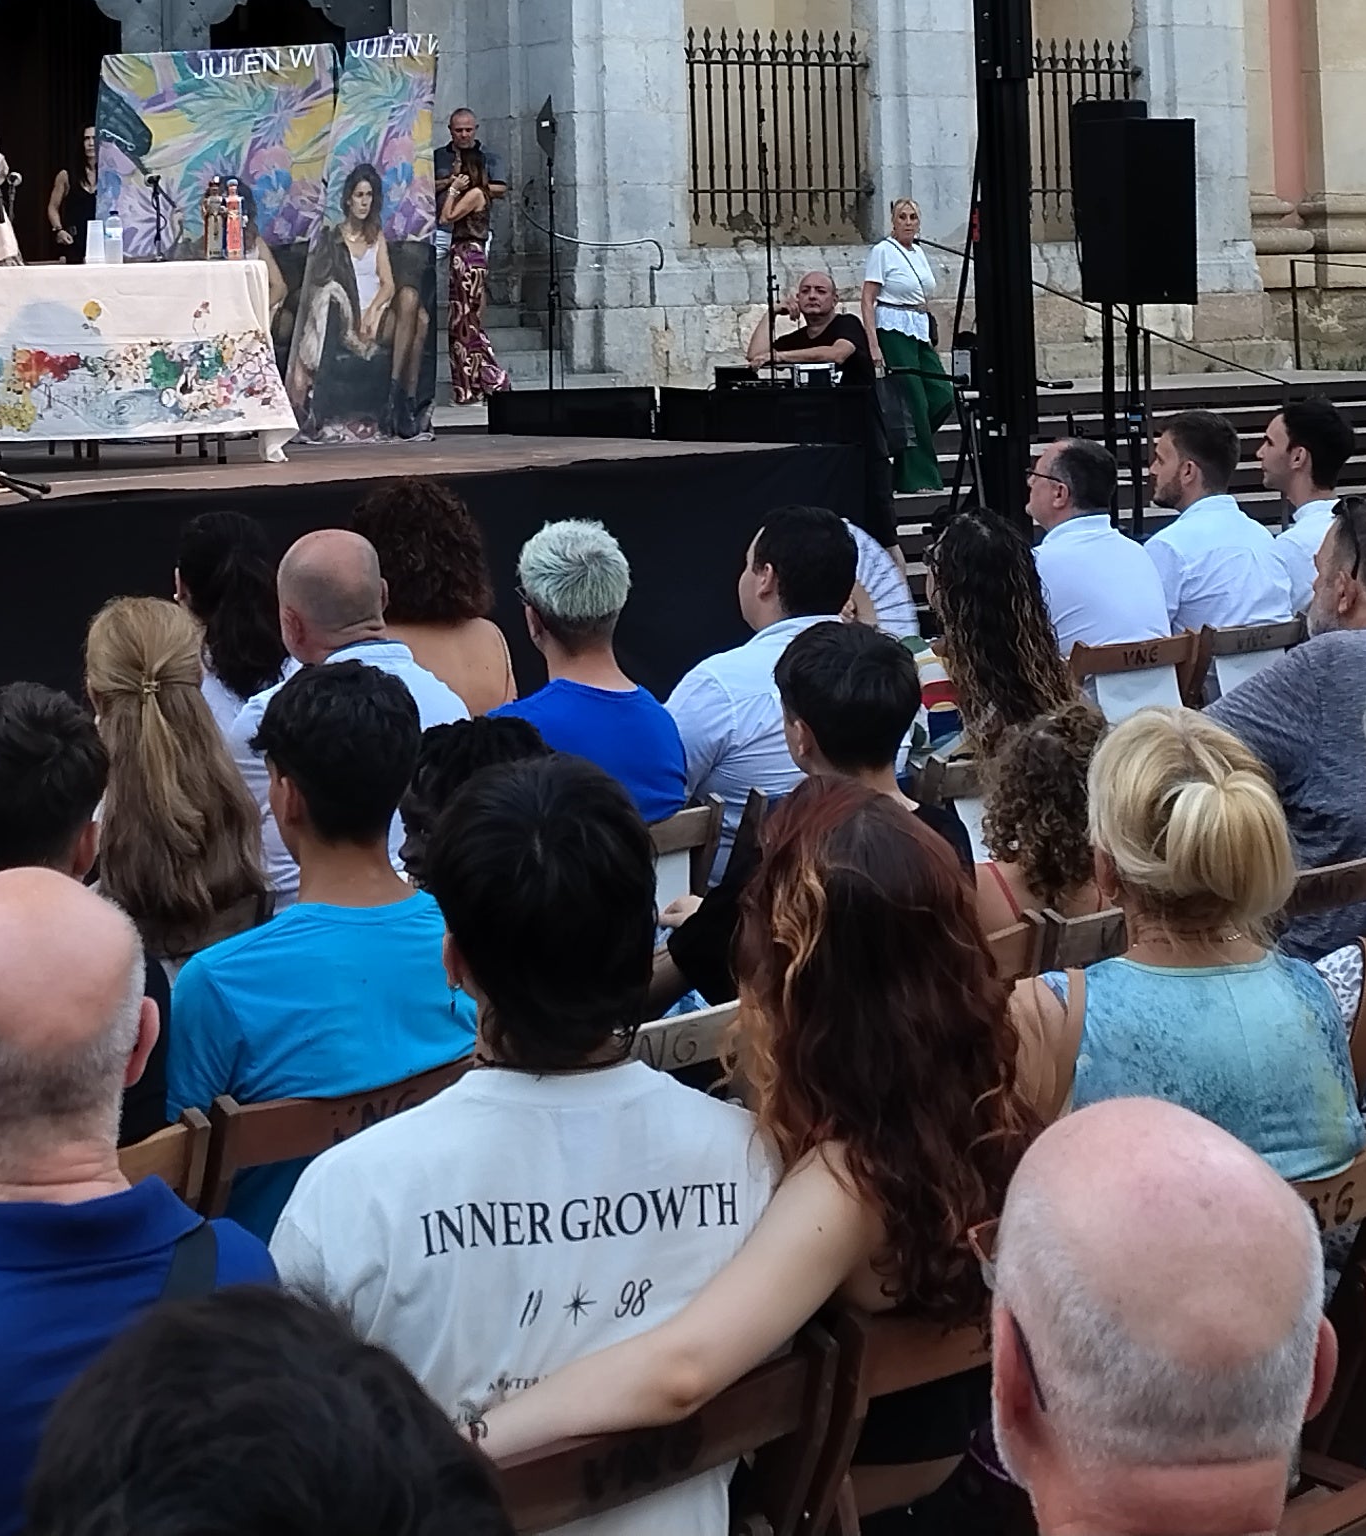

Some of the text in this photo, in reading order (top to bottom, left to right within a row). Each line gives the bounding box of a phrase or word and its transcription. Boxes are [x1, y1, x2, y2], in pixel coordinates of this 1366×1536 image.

[194, 50, 281, 80] JULEN
[350, 36, 421, 59] JULEN
[637, 1023, 698, 1071] NG
[614, 1278, 654, 1319] 98
